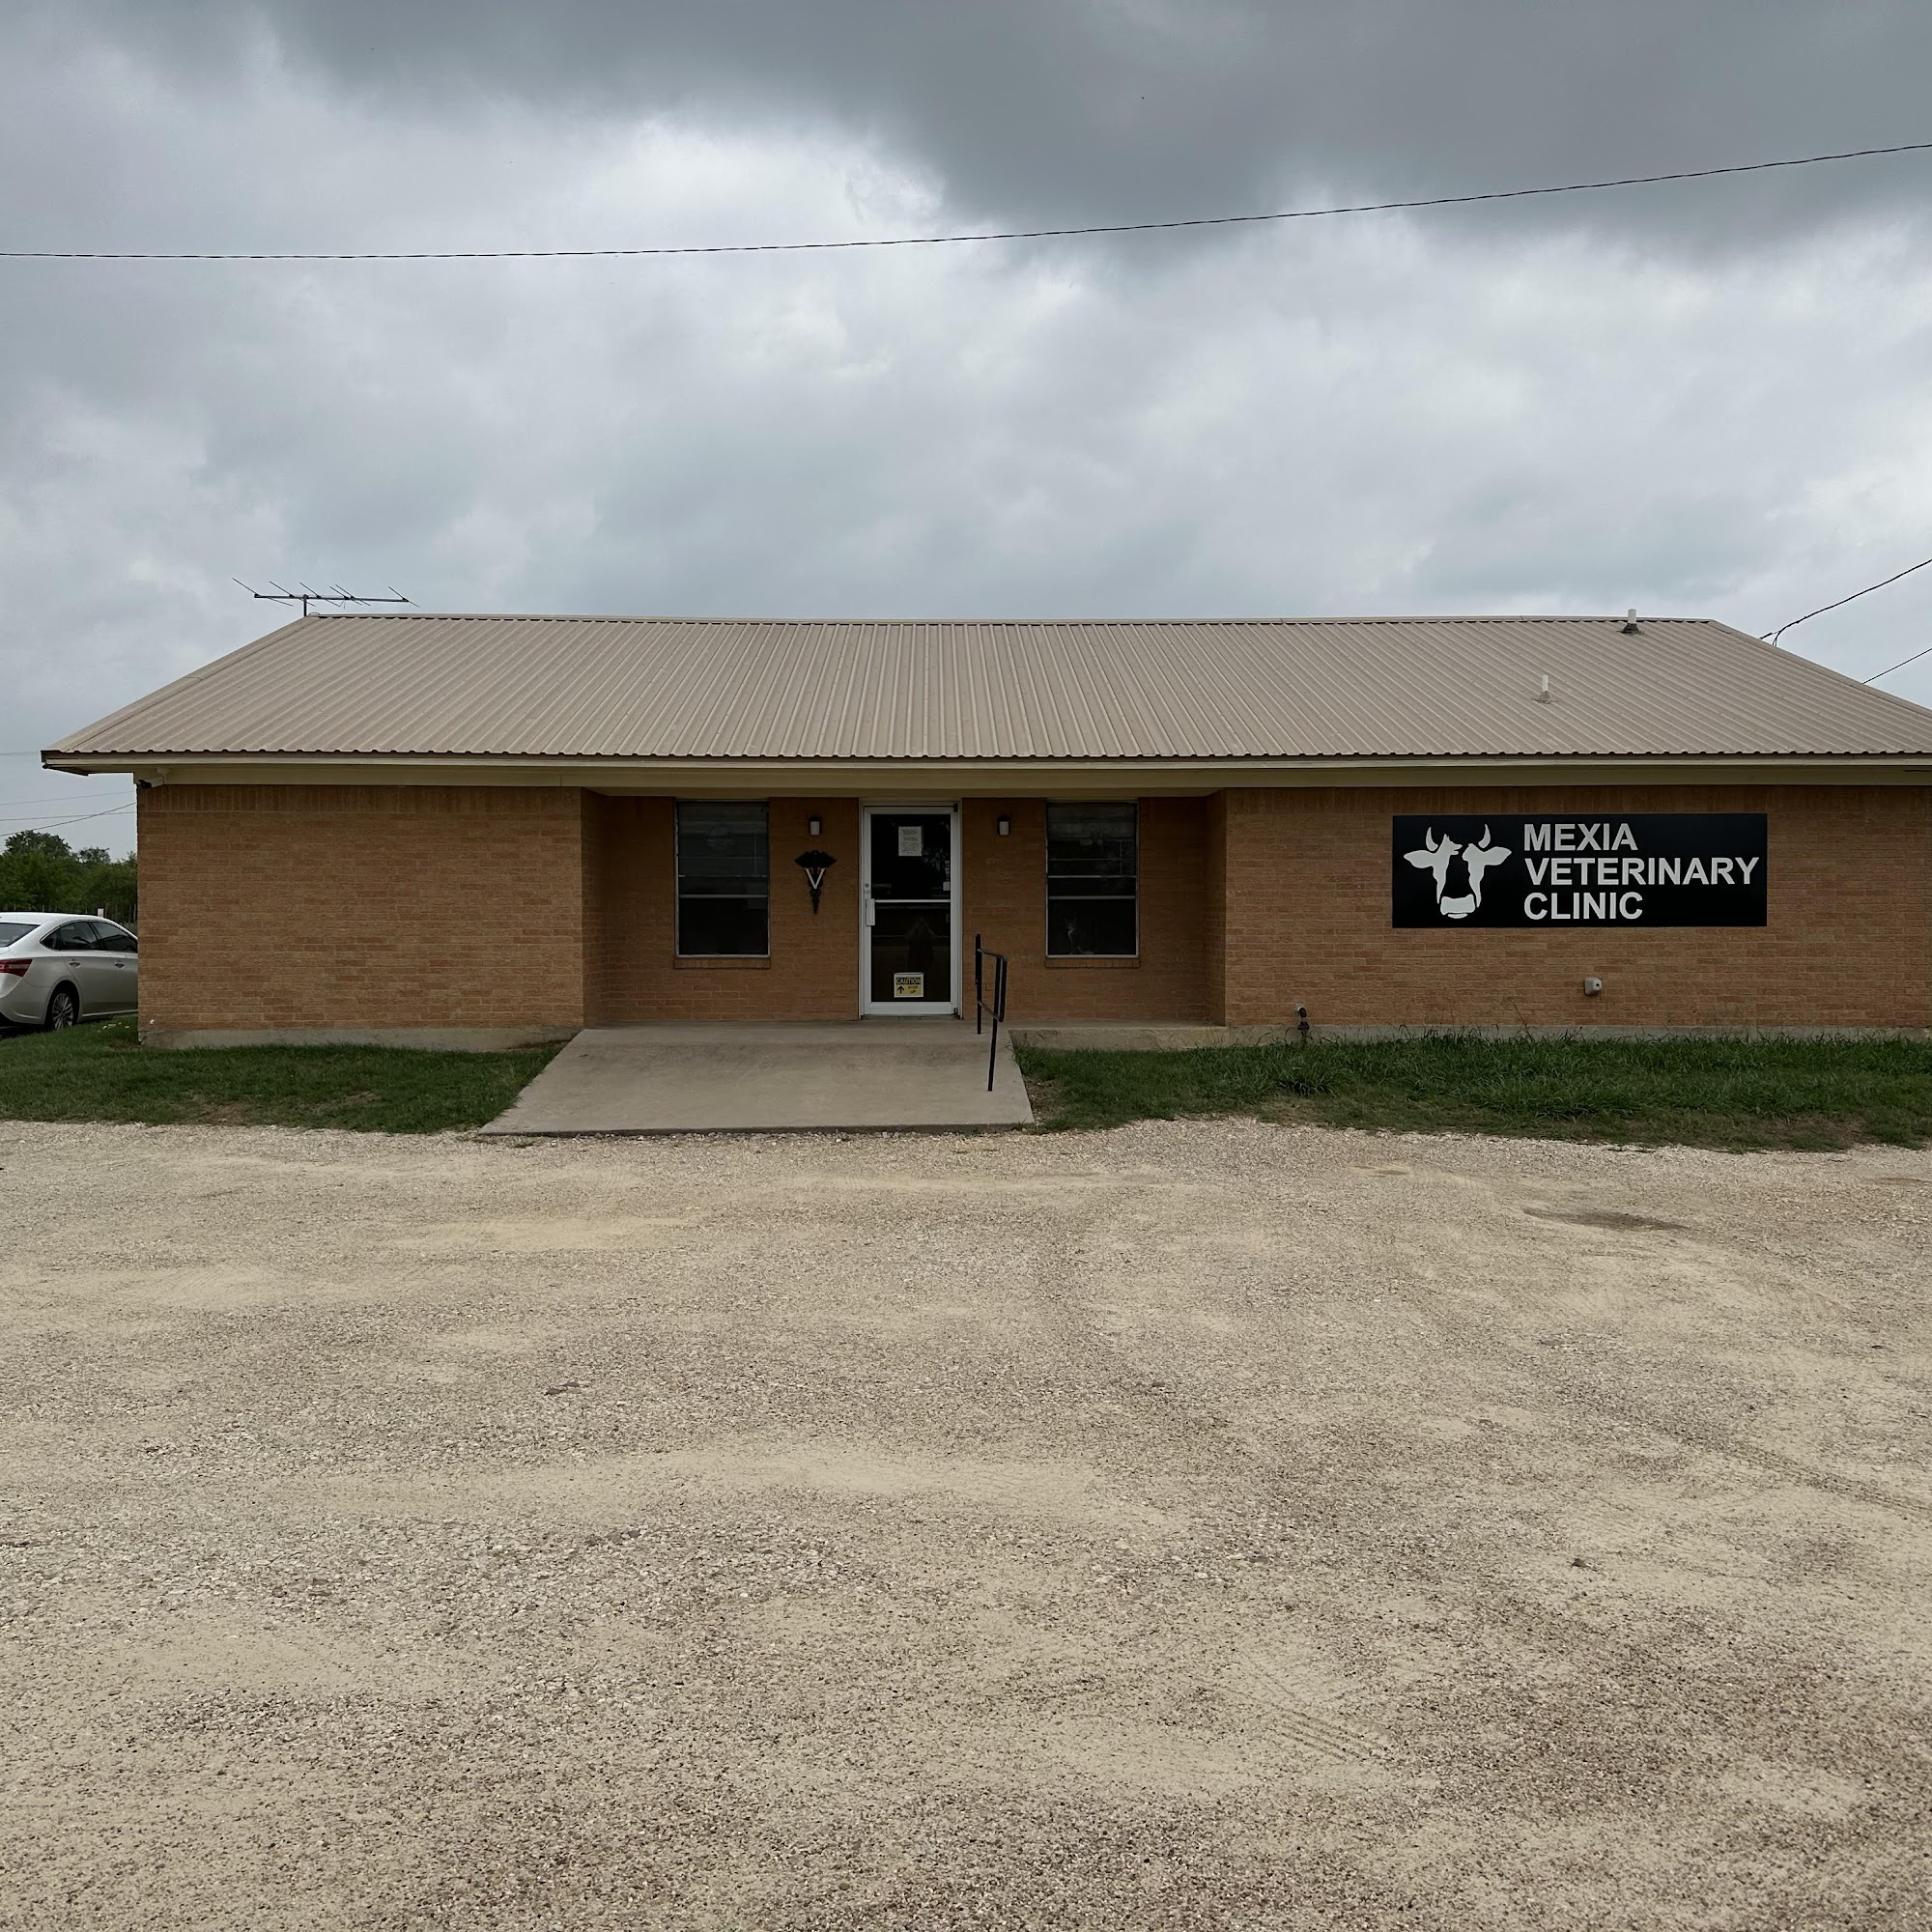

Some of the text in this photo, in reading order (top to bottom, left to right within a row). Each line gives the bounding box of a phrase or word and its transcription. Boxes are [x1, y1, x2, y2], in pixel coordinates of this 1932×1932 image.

[1523, 823, 1638, 851] MEXIA
[1523, 857, 1760, 886] VETERINARY
[1523, 891, 1643, 920] CLINIC
